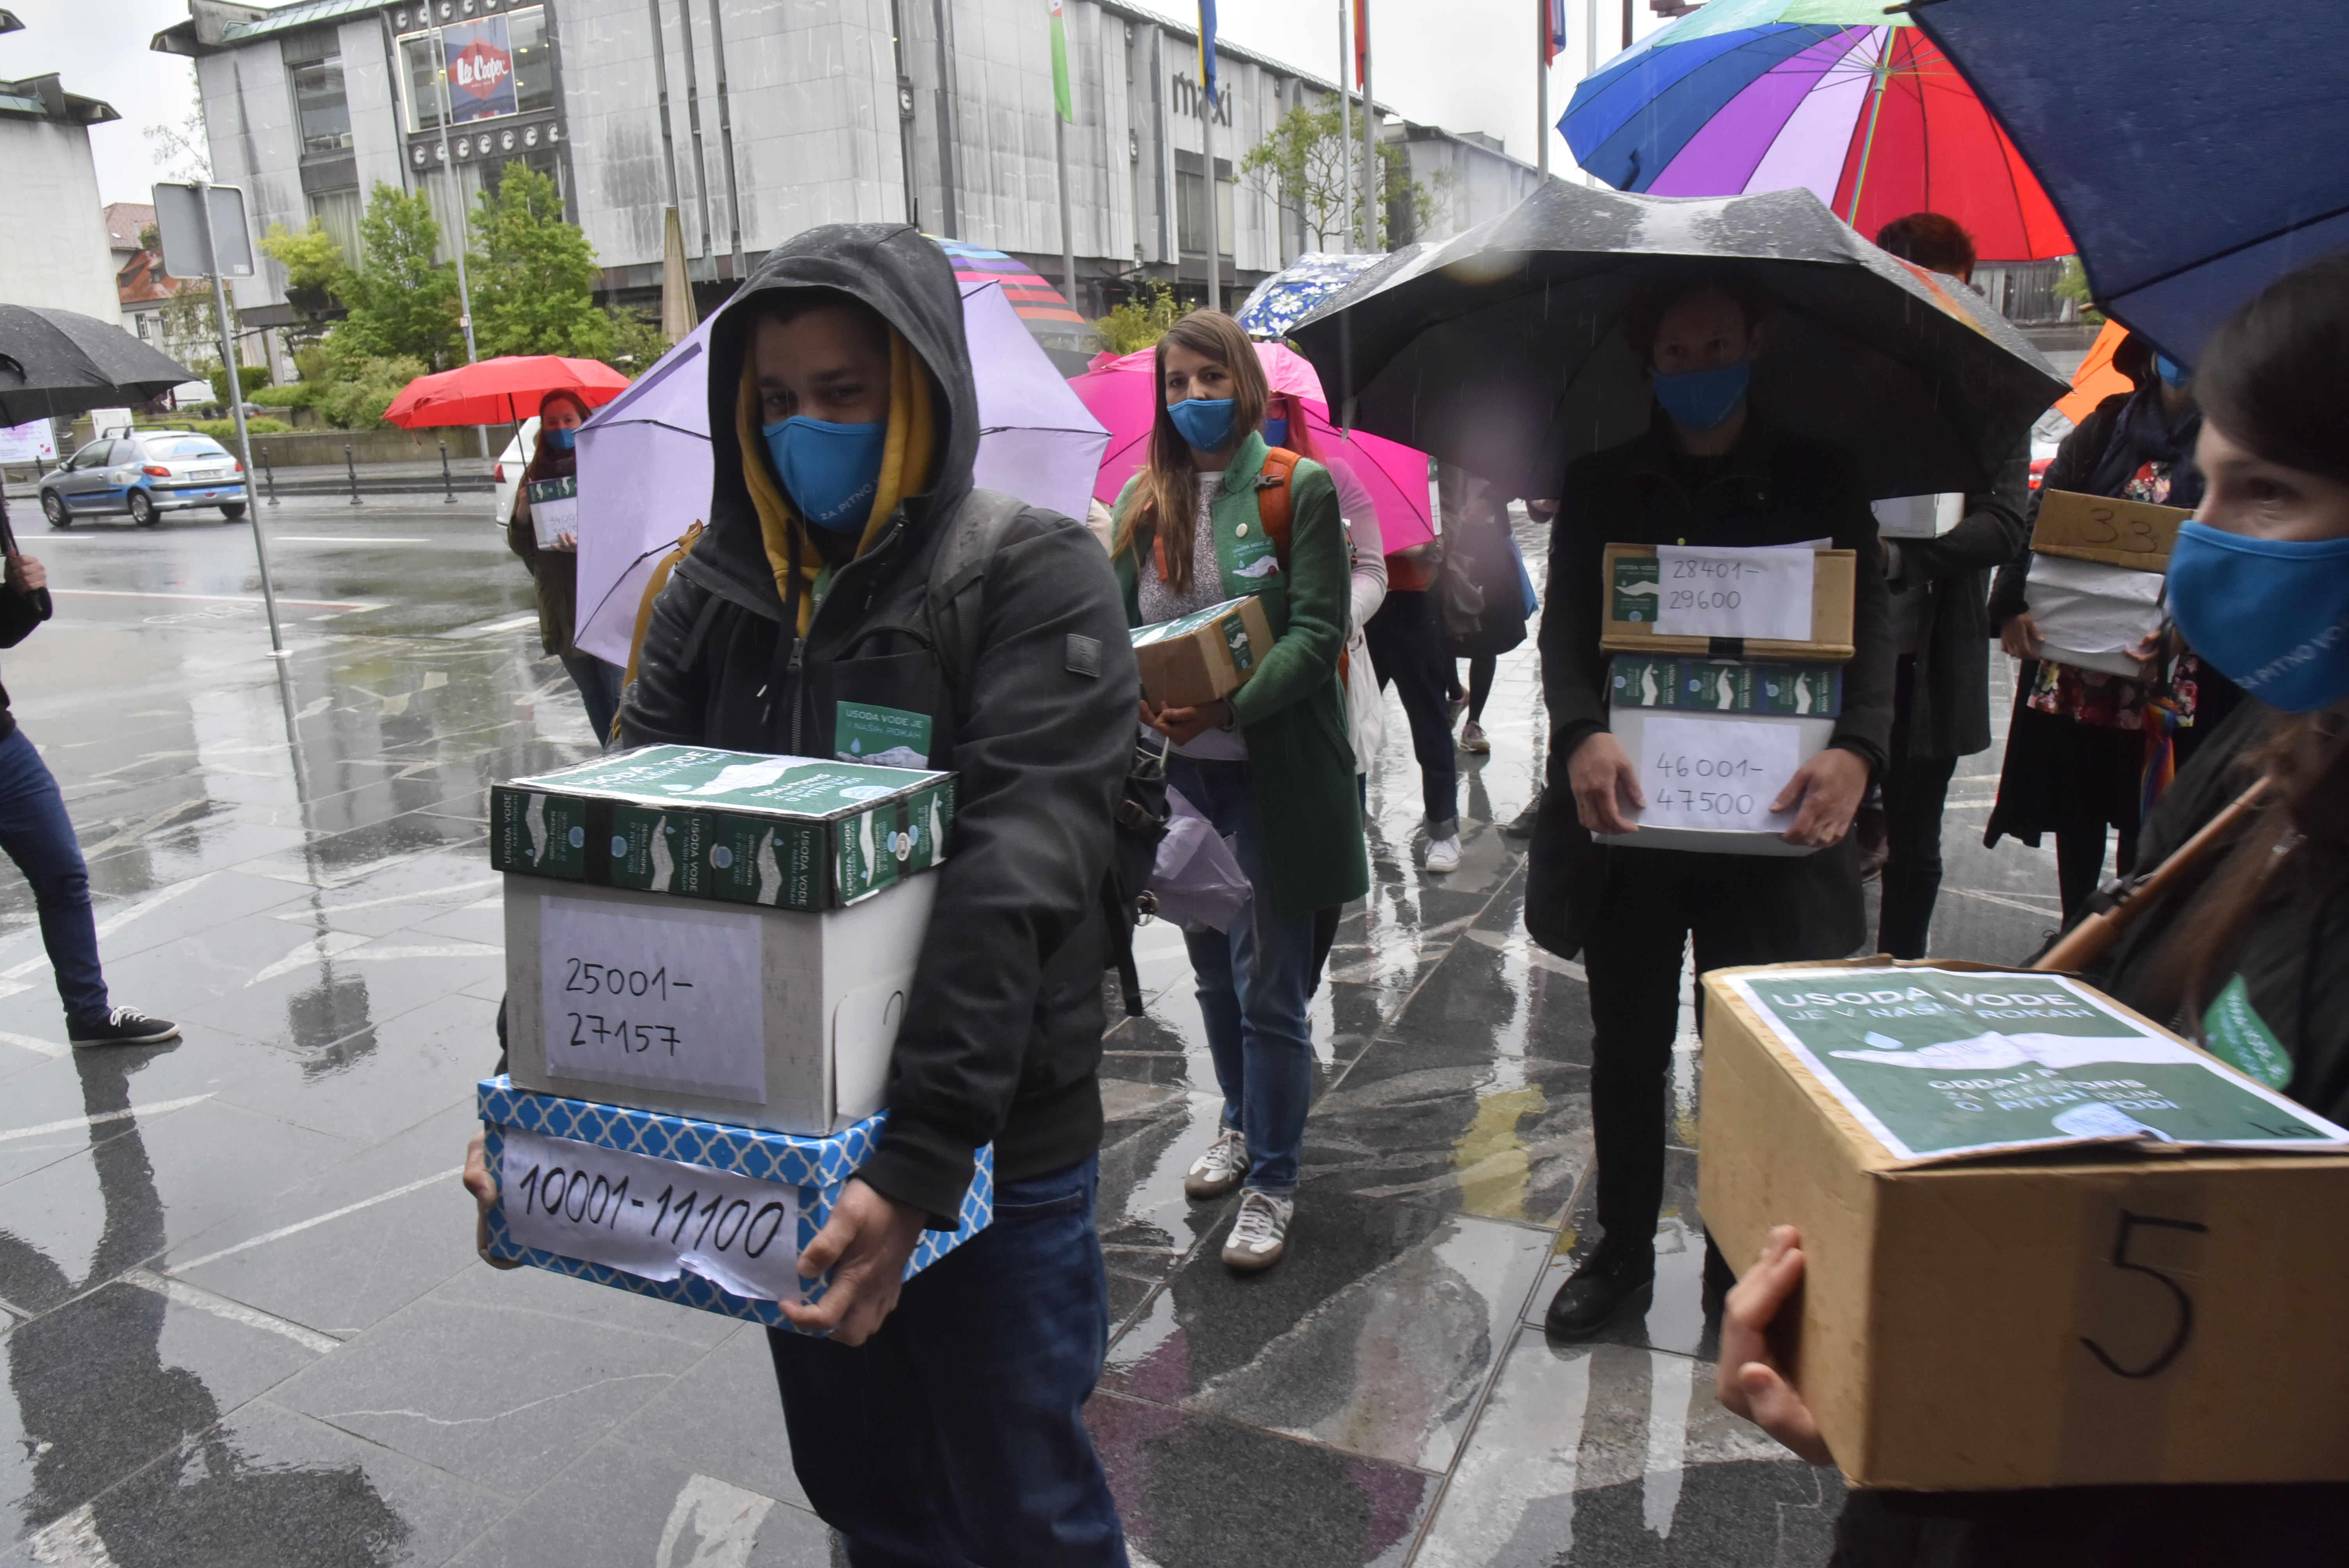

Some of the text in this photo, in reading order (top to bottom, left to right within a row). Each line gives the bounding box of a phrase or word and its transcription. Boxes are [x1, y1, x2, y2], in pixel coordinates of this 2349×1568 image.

[457, 55, 509, 85] Lee Cooper
[820, 484, 873, 520] ZA PITNO
[1672, 560, 1759, 579] 28401-
[1670, 590, 1742, 609] 29600
[845, 709, 923, 728] USODA VODE JE
[1656, 752, 1764, 777] 46001-
[1657, 788, 1755, 814] 47500
[689, 819, 700, 891] USODA VODE
[798, 831, 810, 906] USODA VODE
[565, 956, 695, 1002] 25001-
[1771, 987, 2078, 1007] USODA VODE
[1787, 1009, 1829, 1020] JE
[1831, 1007, 1855, 1017] V
[1974, 1009, 2097, 1019] ROKAH
[567, 1011, 682, 1057] 27157
[519, 1162, 787, 1260] 10001-11100
[2080, 1208, 2210, 1379] 5
